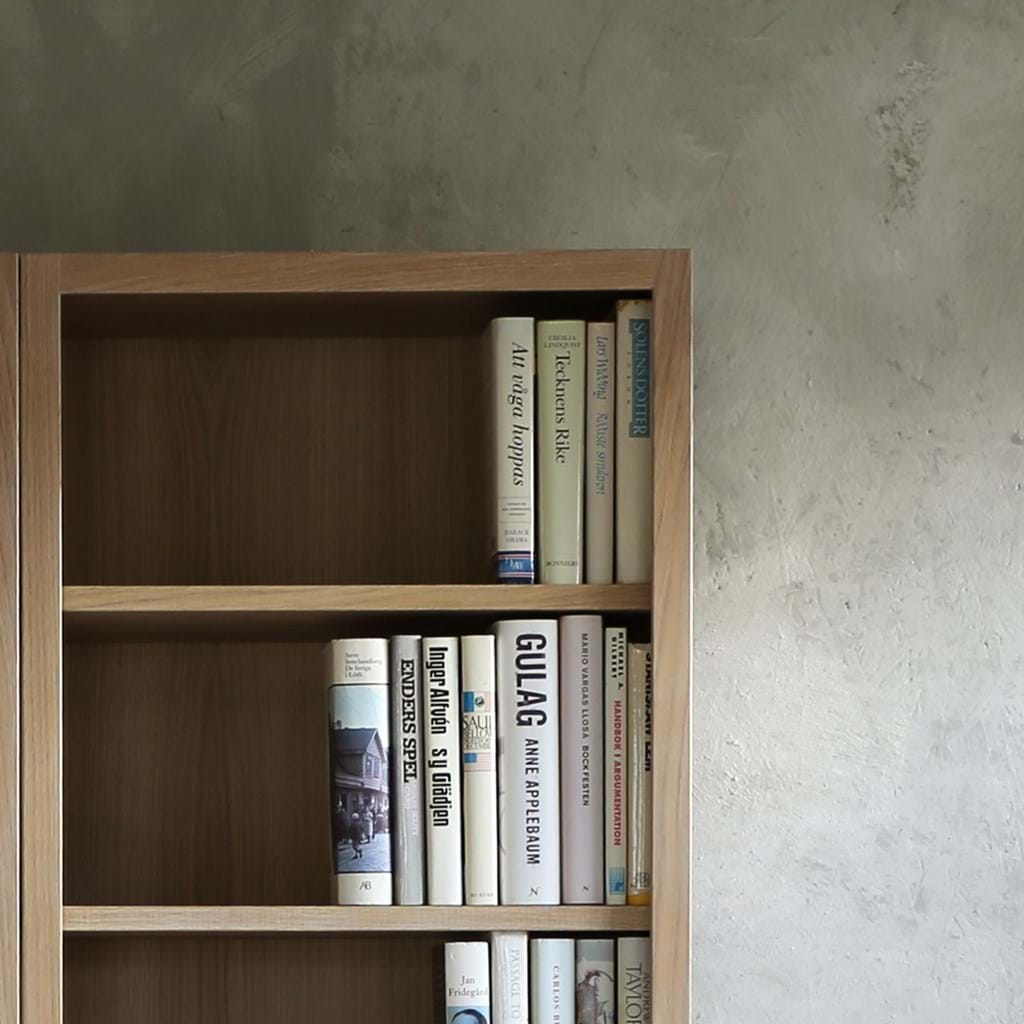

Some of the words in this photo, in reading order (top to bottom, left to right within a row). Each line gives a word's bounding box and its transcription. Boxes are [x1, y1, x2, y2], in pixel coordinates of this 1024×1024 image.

[511, 342, 528, 371] Att
[633, 321, 648, 376] SOLENS
[508, 373, 527, 419] våga
[555, 351, 571, 424] Tecknens
[633, 379, 648, 435] DOTTER
[508, 422, 529, 486] hoppas
[555, 428, 570, 463] Rike
[425, 646, 449, 686] Inger
[516, 633, 547, 727] GULAG
[400, 658, 417, 734] ENDERS
[429, 687, 450, 735] Alfvén
[613, 700, 622, 750] HANDBOK
[403, 737, 418, 783] SPEL
[525, 738, 539, 777] ANNE
[582, 745, 590, 806] BOCKFESTEN
[429, 772, 452, 827] Glädjen
[525, 780, 540, 865] APPLEBAUM
[613, 760, 622, 847] ARGUMENTATION
[460, 975, 475, 986] Jan
[510, 949, 521, 999] PASSAGE
[511, 1003, 521, 1019] TO
